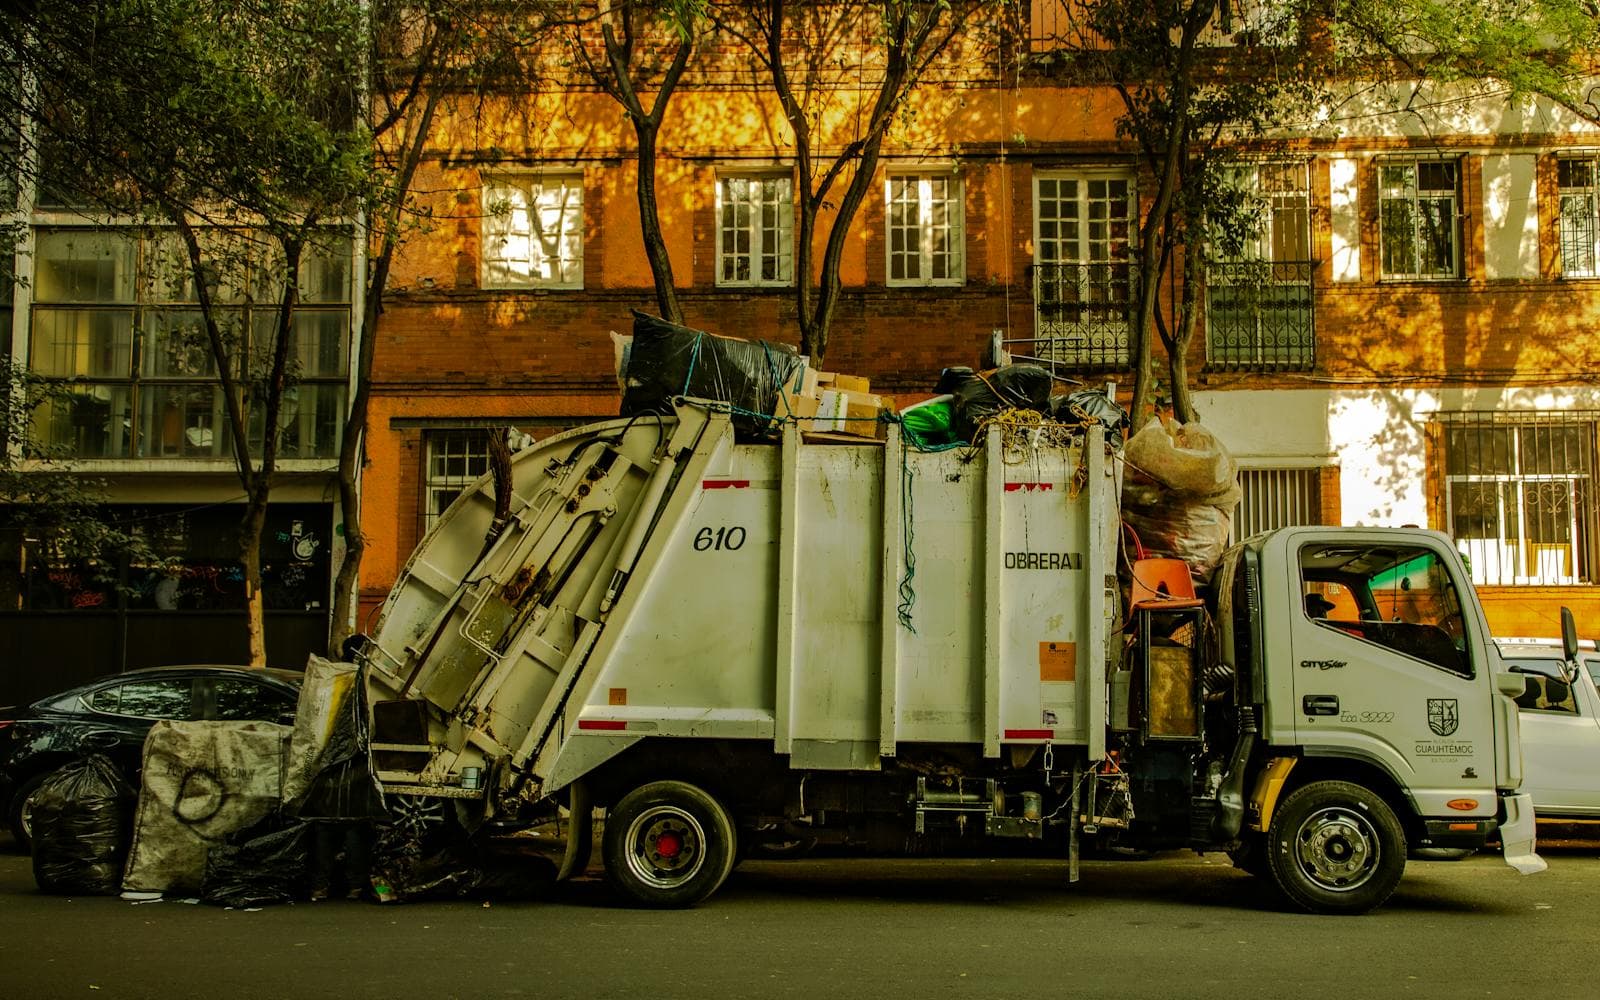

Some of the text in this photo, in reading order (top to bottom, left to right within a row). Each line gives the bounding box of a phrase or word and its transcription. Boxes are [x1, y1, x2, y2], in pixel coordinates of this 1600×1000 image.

[693, 526, 747, 552] 610
[1004, 552, 1072, 570] OBRERA
[1415, 743, 1474, 754] CUAUHTÉMOC
